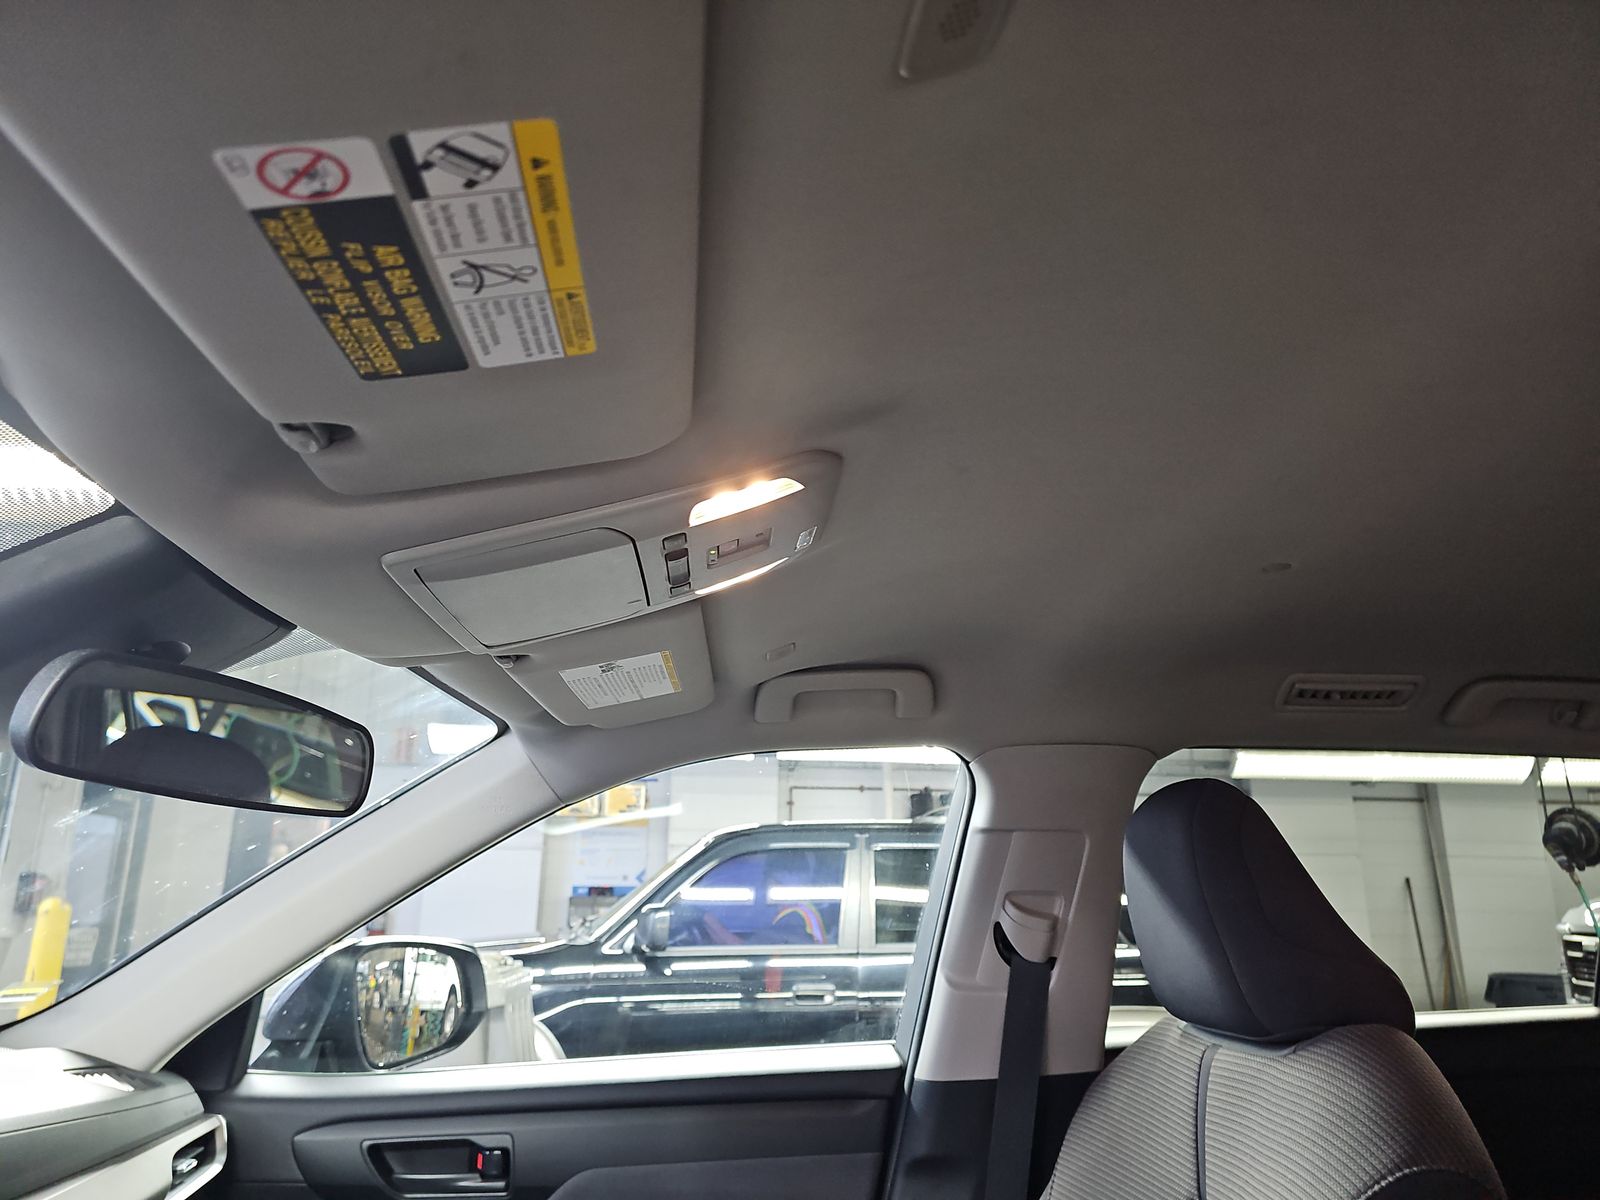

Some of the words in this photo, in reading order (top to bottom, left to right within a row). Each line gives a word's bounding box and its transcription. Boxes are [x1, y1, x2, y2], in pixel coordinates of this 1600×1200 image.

[373, 245, 405, 267] AIR
[341, 242, 374, 273] FLIP
[361, 280, 396, 316] VISOR
[384, 321, 414, 349] OVER
[385, 268, 418, 295] BAG
[400, 296, 441, 344] WARNING
